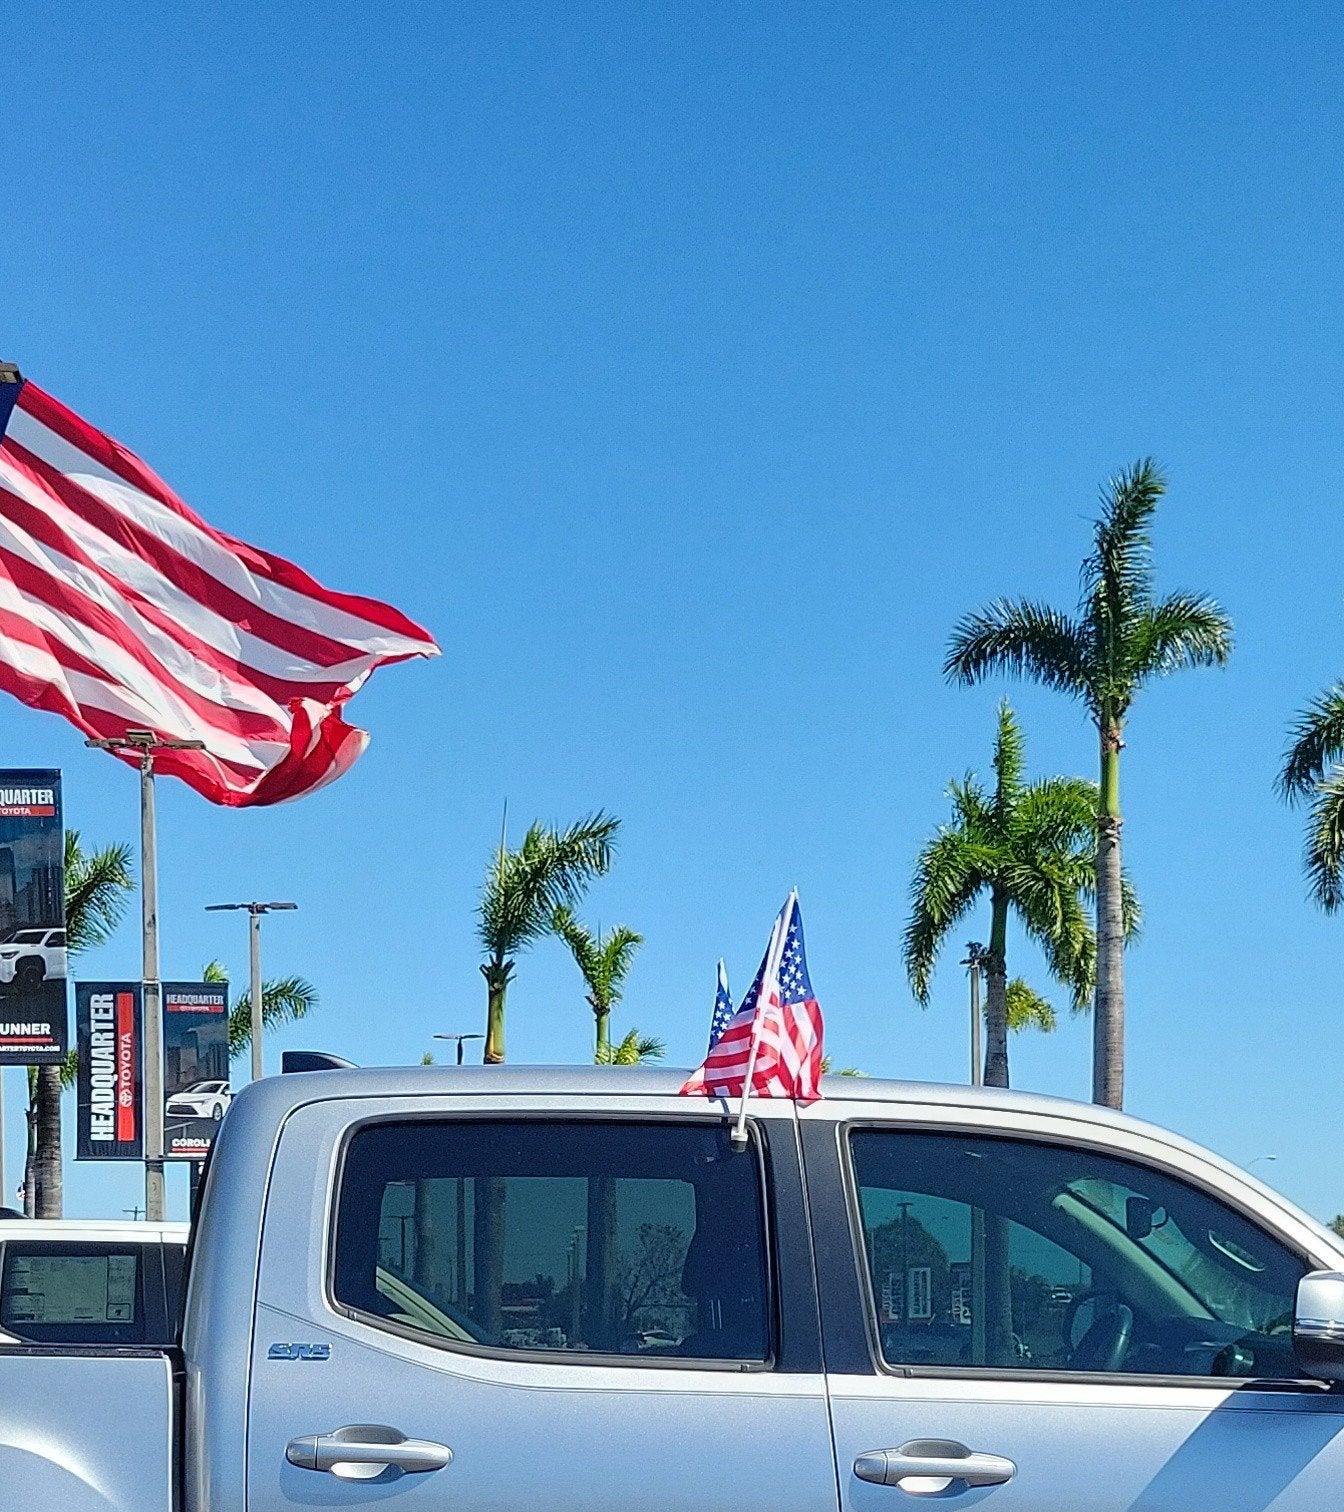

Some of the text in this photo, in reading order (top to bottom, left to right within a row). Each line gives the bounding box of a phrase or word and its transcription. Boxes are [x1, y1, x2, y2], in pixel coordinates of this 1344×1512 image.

[166, 993, 225, 1006] HEADQUARTER
[90, 993, 119, 1141] HEADQUARTER
[121, 1032, 132, 1087] TOYOTA
[267, 1342, 333, 1361] SR5
